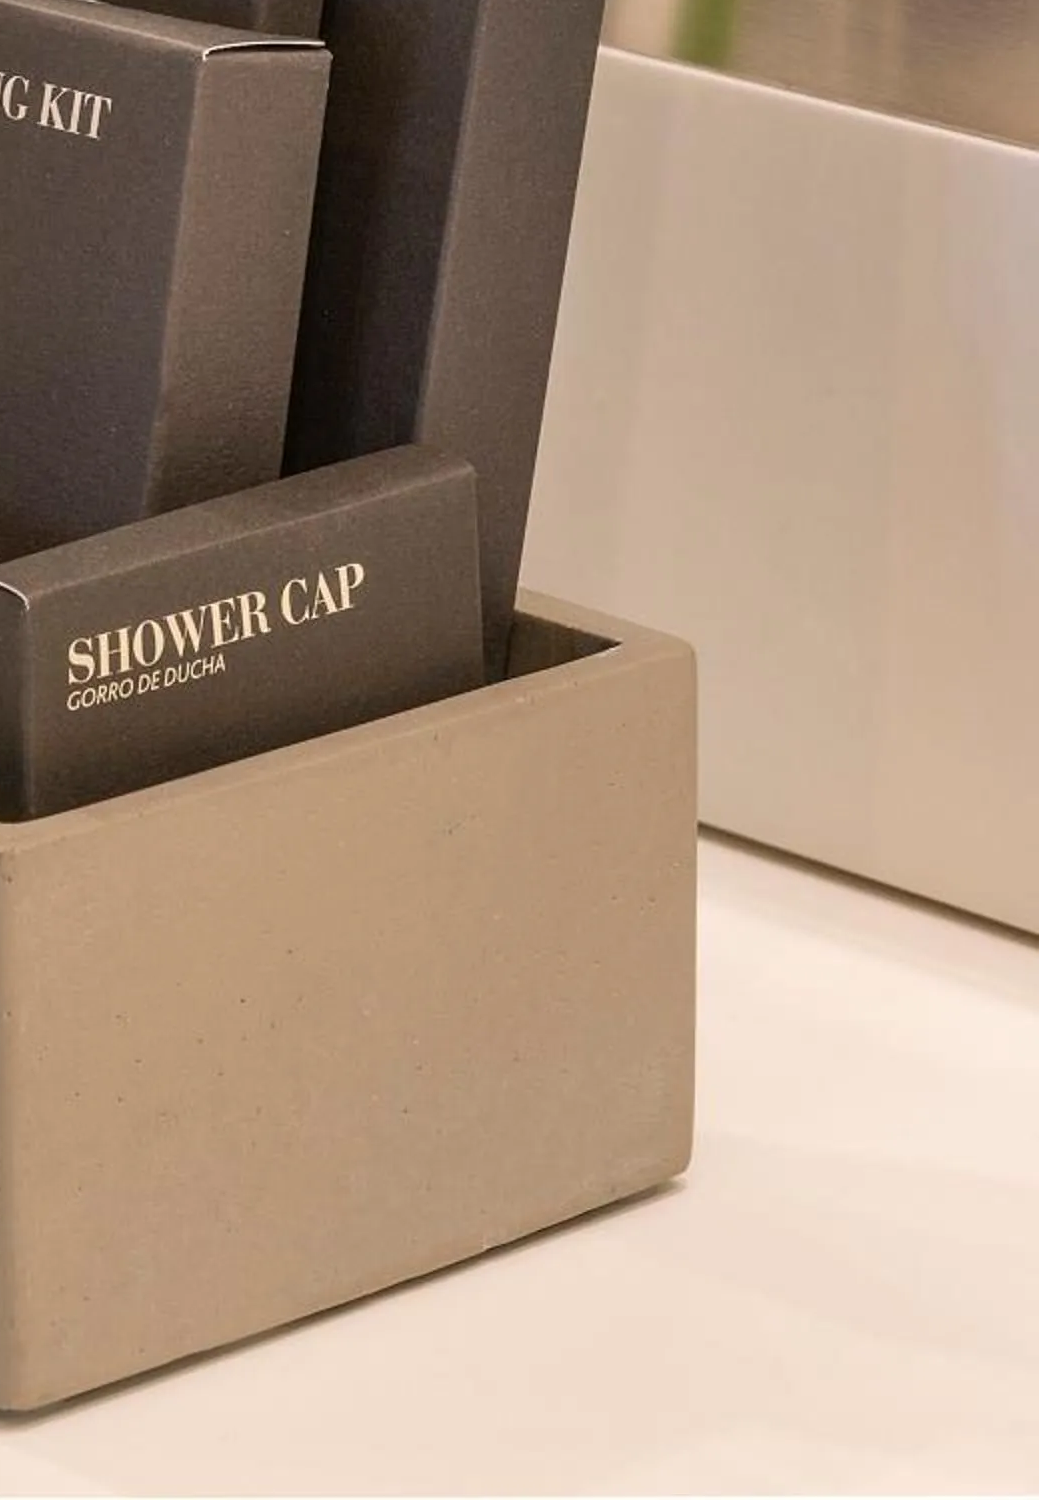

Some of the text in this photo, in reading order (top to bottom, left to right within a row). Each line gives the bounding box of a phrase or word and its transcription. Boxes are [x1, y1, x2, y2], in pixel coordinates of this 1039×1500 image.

[37, 82, 113, 140] KIT
[68, 563, 365, 685] SHOWER CAP
[66, 652, 226, 711] GORRO DE DUCHA
